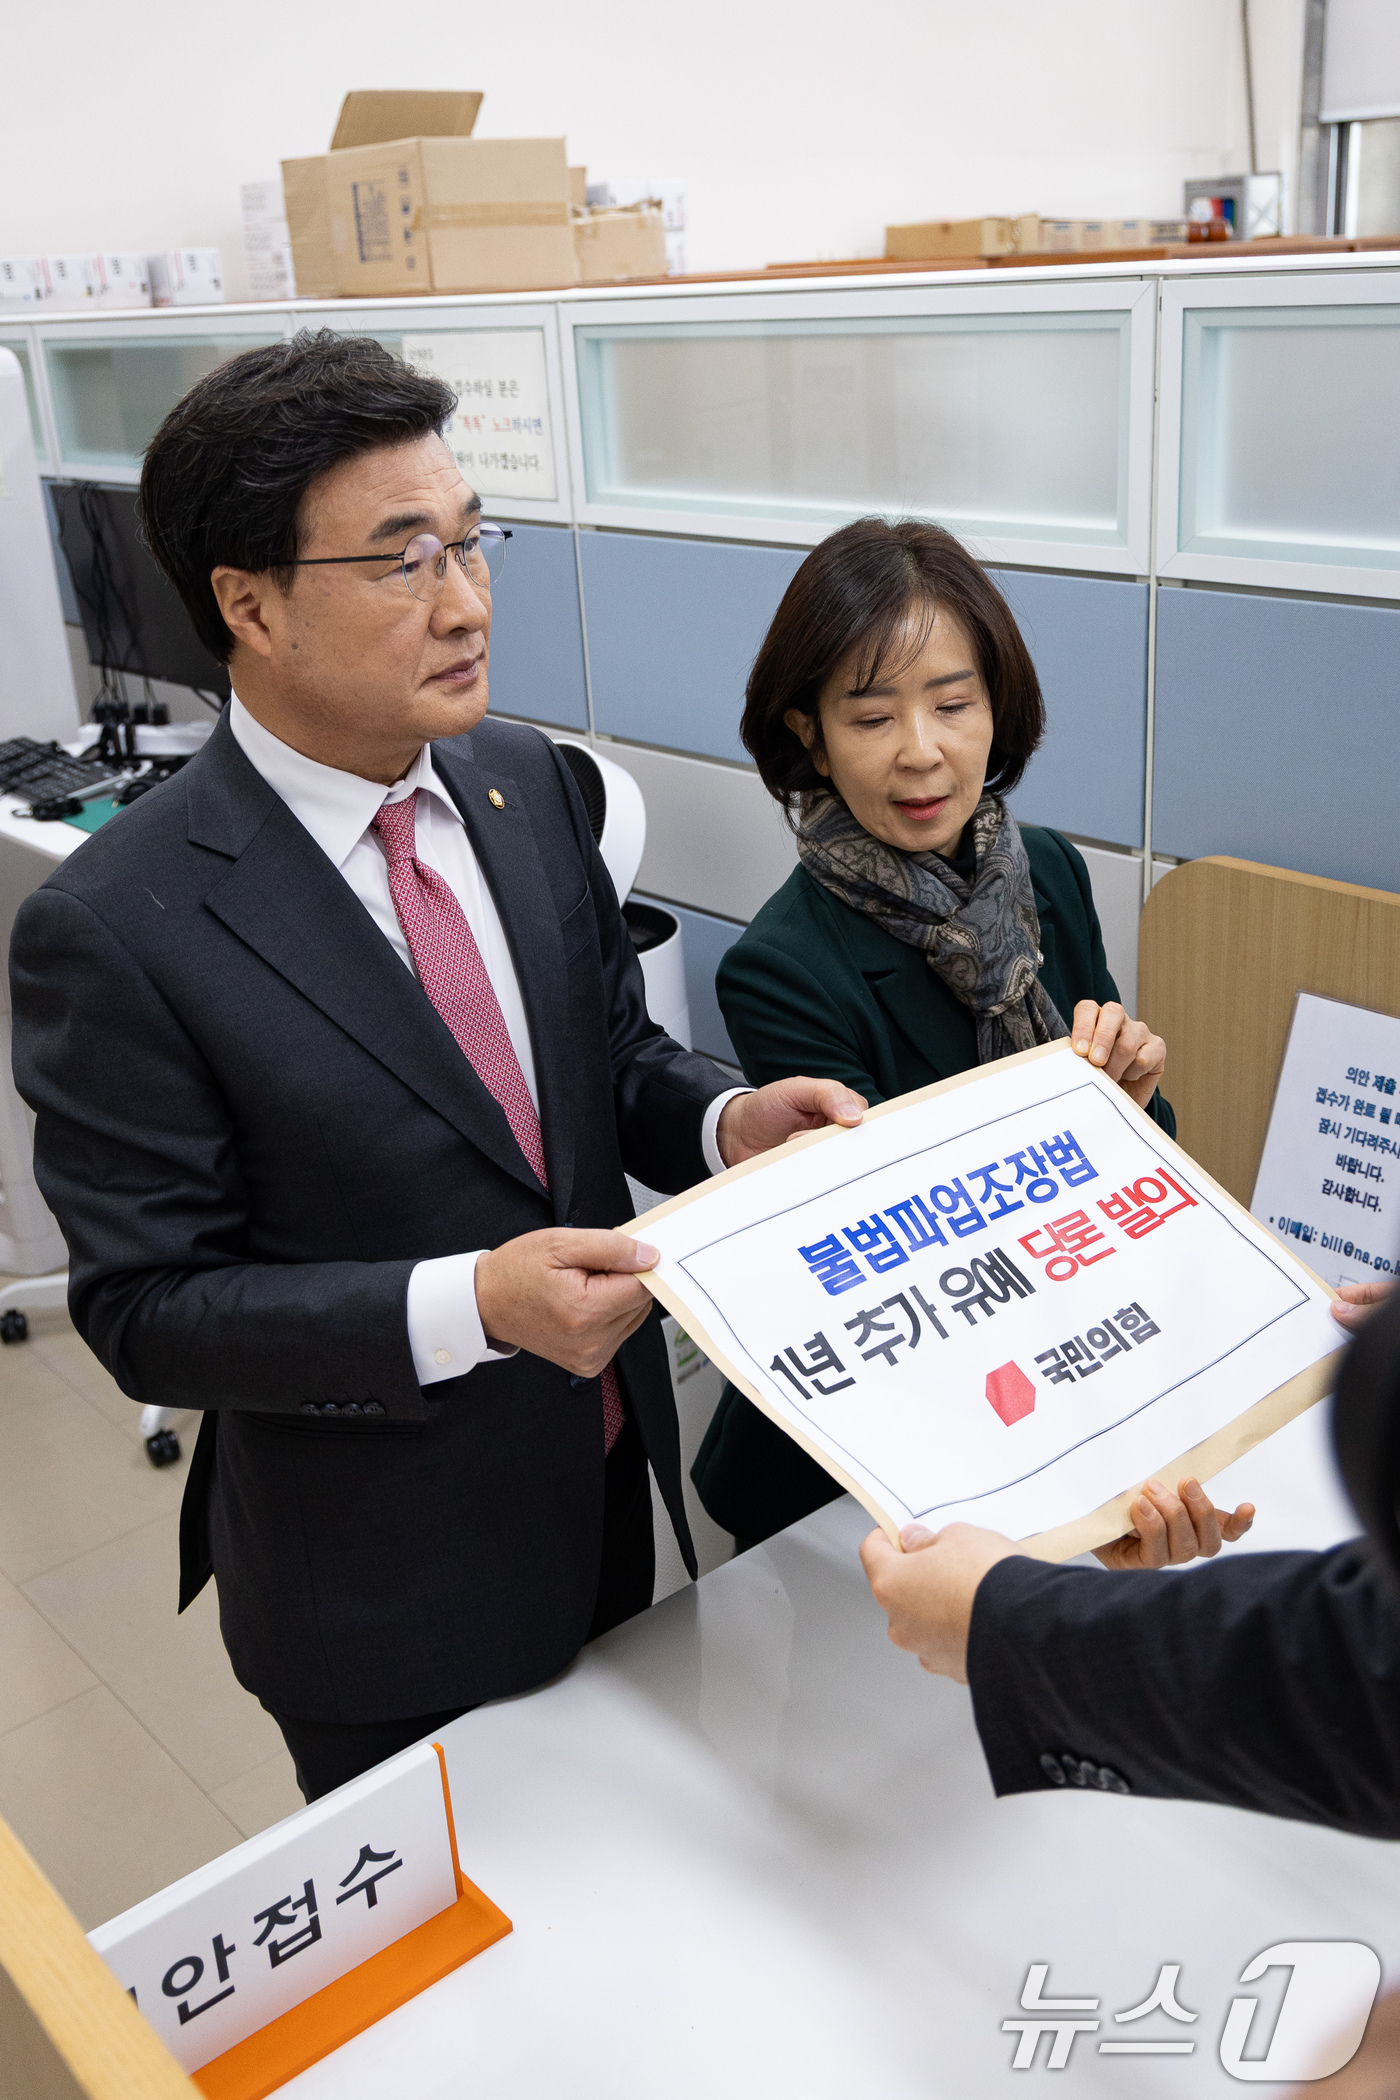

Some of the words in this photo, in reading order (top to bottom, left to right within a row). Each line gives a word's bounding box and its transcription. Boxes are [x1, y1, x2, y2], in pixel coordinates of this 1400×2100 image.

[1345, 1066, 1370, 1088] 의안
[1372, 1074, 1397, 1096] 제출
[1315, 1086, 1350, 1112] 접수가
[1353, 1098, 1376, 1119] 완료
[1318, 1117, 1342, 1139] 잠시
[1335, 1153, 1385, 1183] 바랍니다.
[797, 1130, 1099, 1296] 불법파업조장법
[1321, 1178, 1382, 1213] 감사합니다.
[770, 1331, 856, 1400] 1년
[844, 1285, 949, 1367] 추가
[939, 1247, 1036, 1326] 유예
[1017, 1209, 1116, 1281] 당론
[1096, 1167, 1199, 1240] 발의
[1033, 1302, 1162, 1385] 국민의힘
[126, 1843, 403, 2026] 안접수
